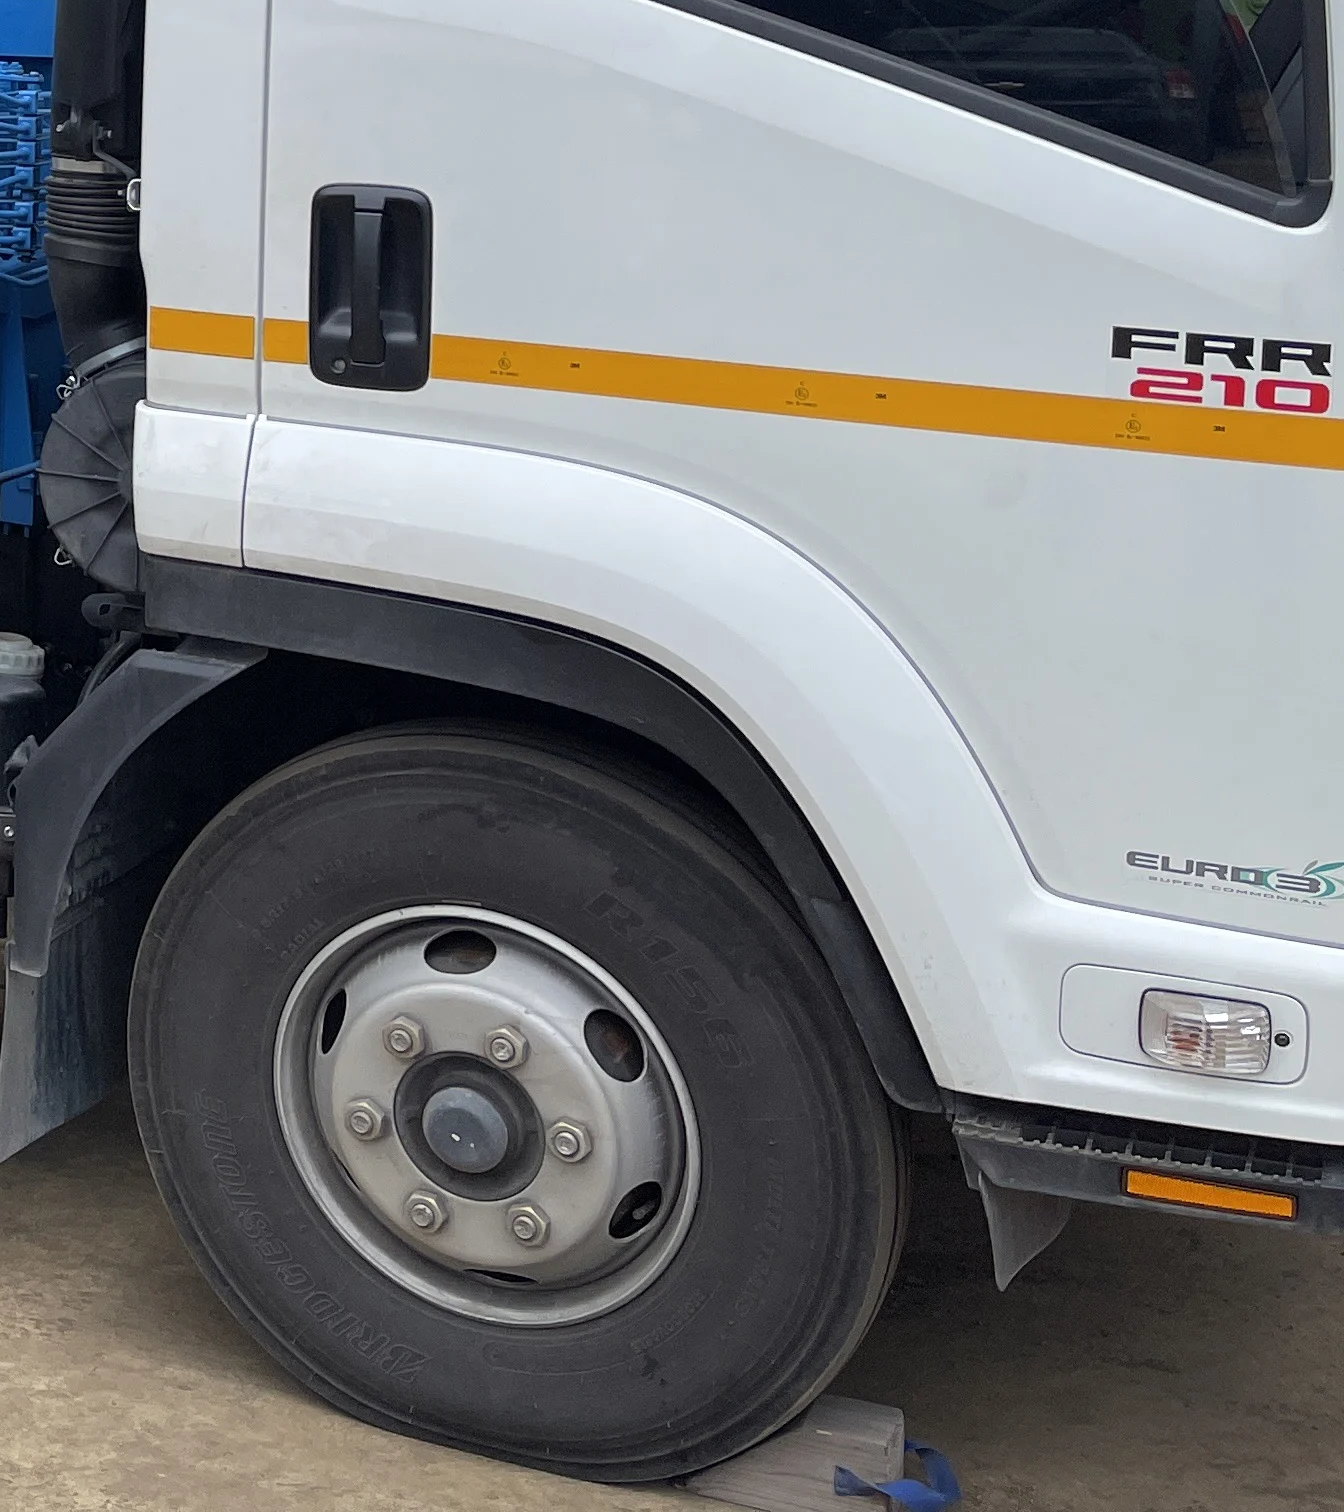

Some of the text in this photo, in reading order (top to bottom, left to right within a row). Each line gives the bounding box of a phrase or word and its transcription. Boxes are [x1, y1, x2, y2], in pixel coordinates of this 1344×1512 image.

[1111, 326, 1332, 378] FRR
[1130, 367, 1330, 414] 210
[1148, 875, 1205, 889] SUPER
[193, 1088, 434, 1383] BRIDGESTONE
